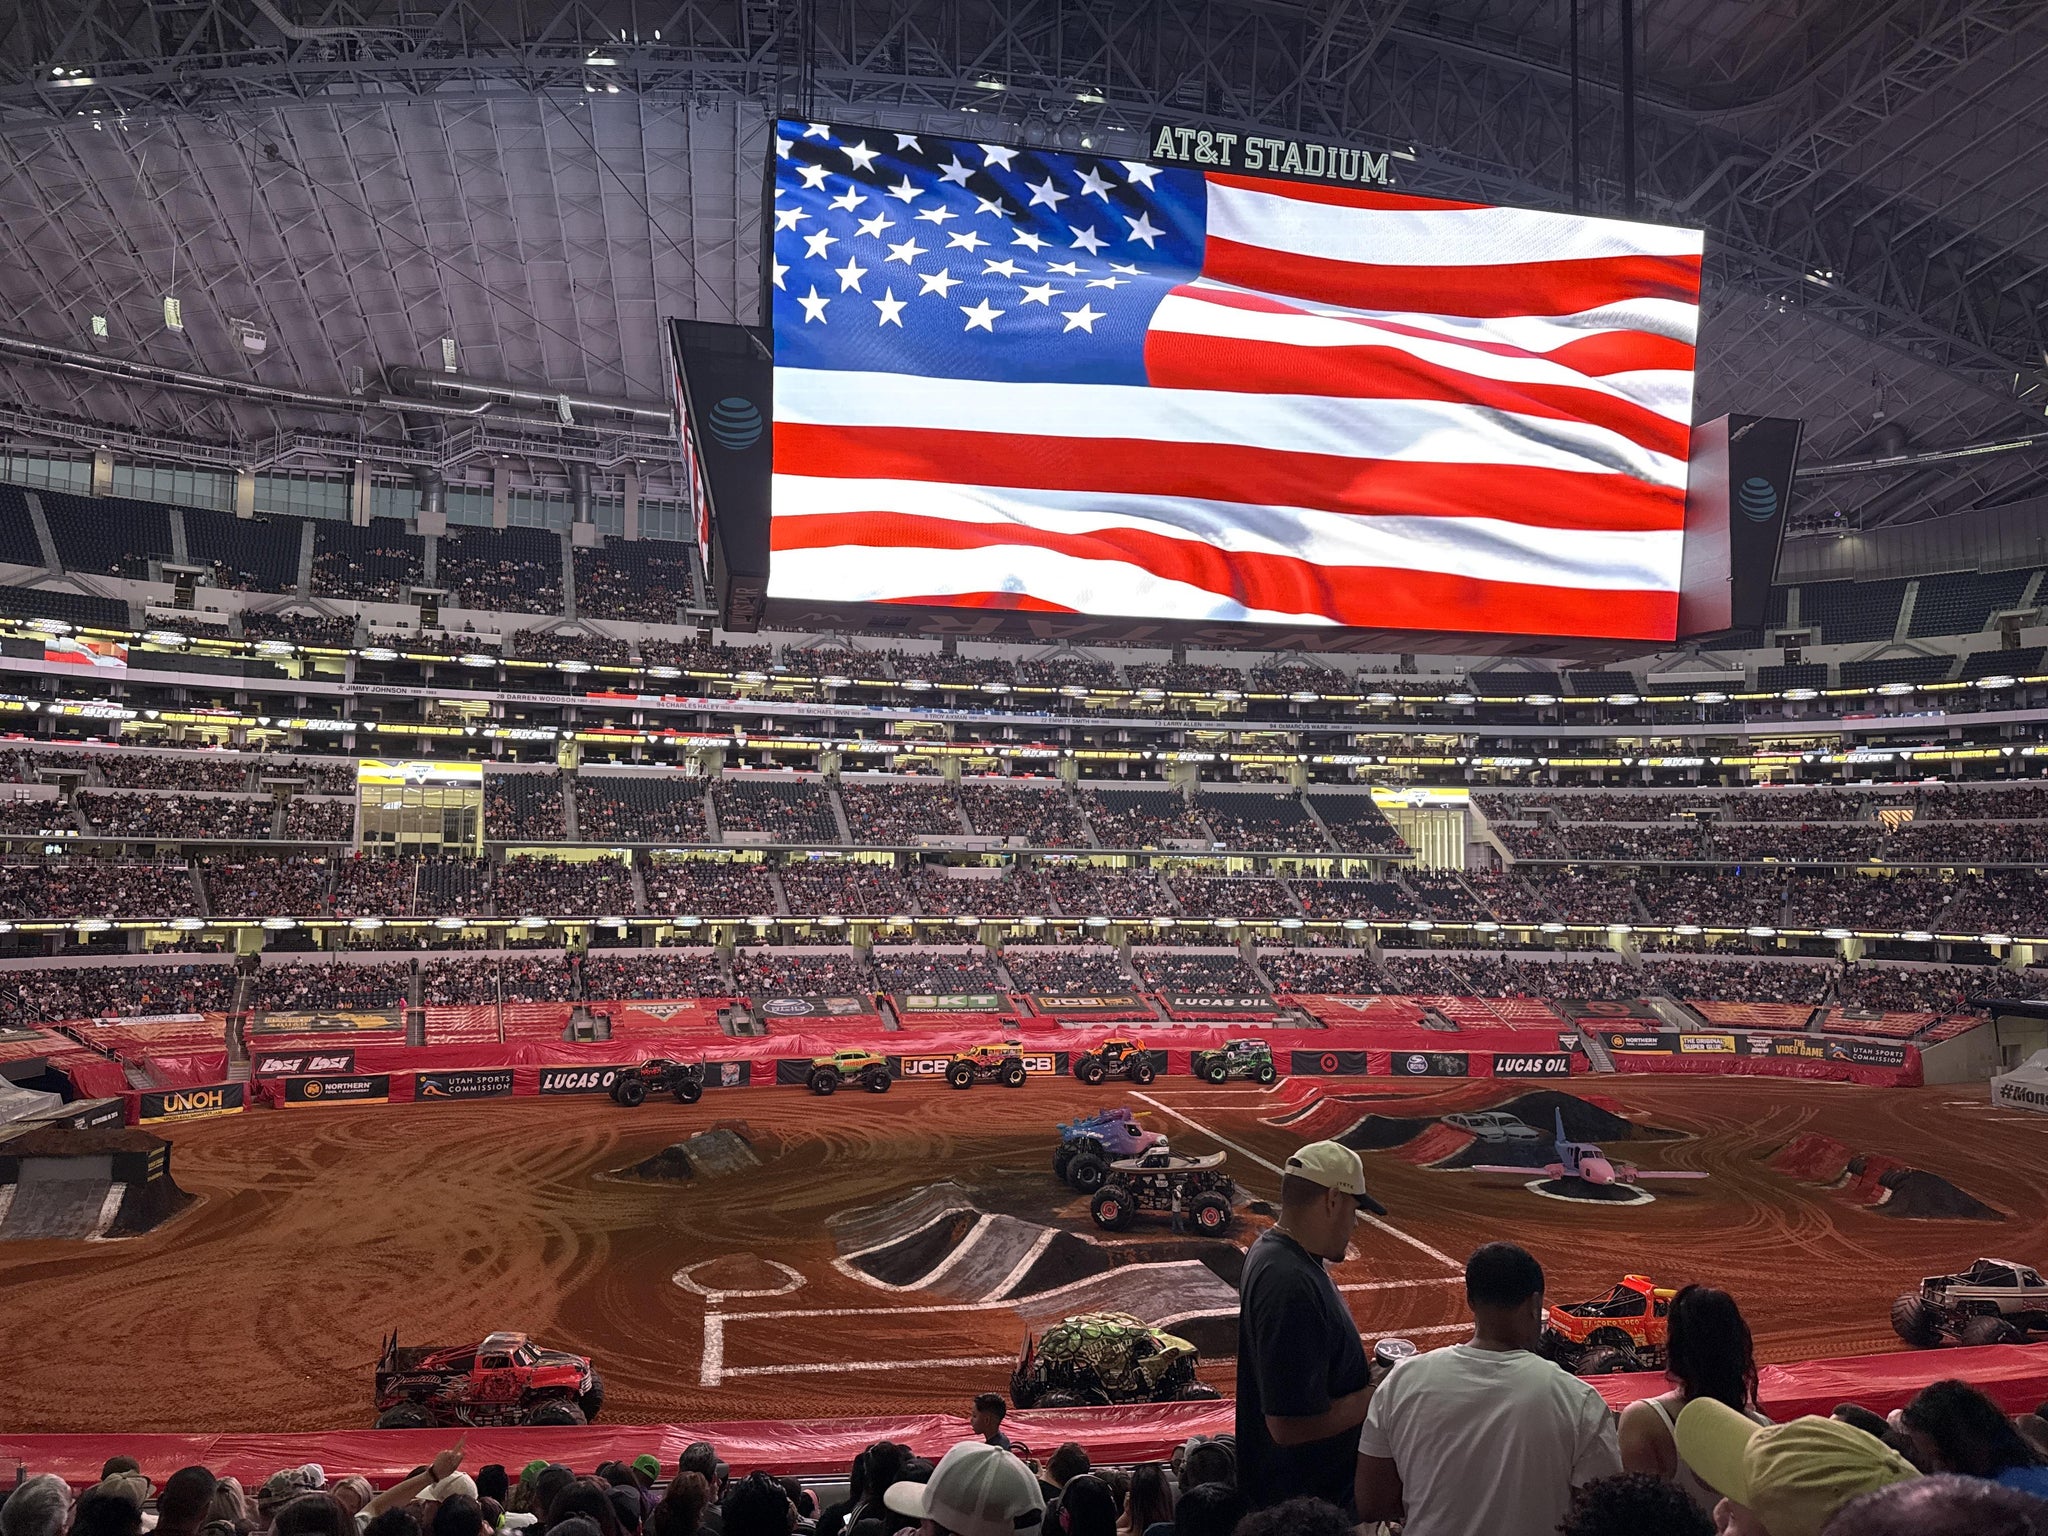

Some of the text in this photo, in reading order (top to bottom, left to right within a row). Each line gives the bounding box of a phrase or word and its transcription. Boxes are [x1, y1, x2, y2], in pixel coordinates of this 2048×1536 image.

[1152, 126, 1389, 185] AT&T STADIUM
[371, 686, 407, 694] JOHNSON
[908, 995, 996, 1006] BKT
[1174, 998, 1270, 1006] LUCAS OIL
[625, 1003, 695, 1011] MONSTER
[1793, 1039, 1806, 1047] THE
[1776, 1045, 1799, 1054] VIDEO
[1800, 1046, 1824, 1058] GAME
[1023, 1057, 1051, 1071] CB
[1852, 1054, 1902, 1064] COMMISSION
[906, 1060, 948, 1074] JCB
[1495, 1059, 1567, 1072] LUCAS OIL
[448, 1075, 511, 1085] UTAH SPORTS
[543, 1072, 598, 1089] LUCAS
[325, 1082, 370, 1090] NORTHERN
[448, 1083, 510, 1093] COMMISSION
[163, 1090, 223, 1112] UNOH
